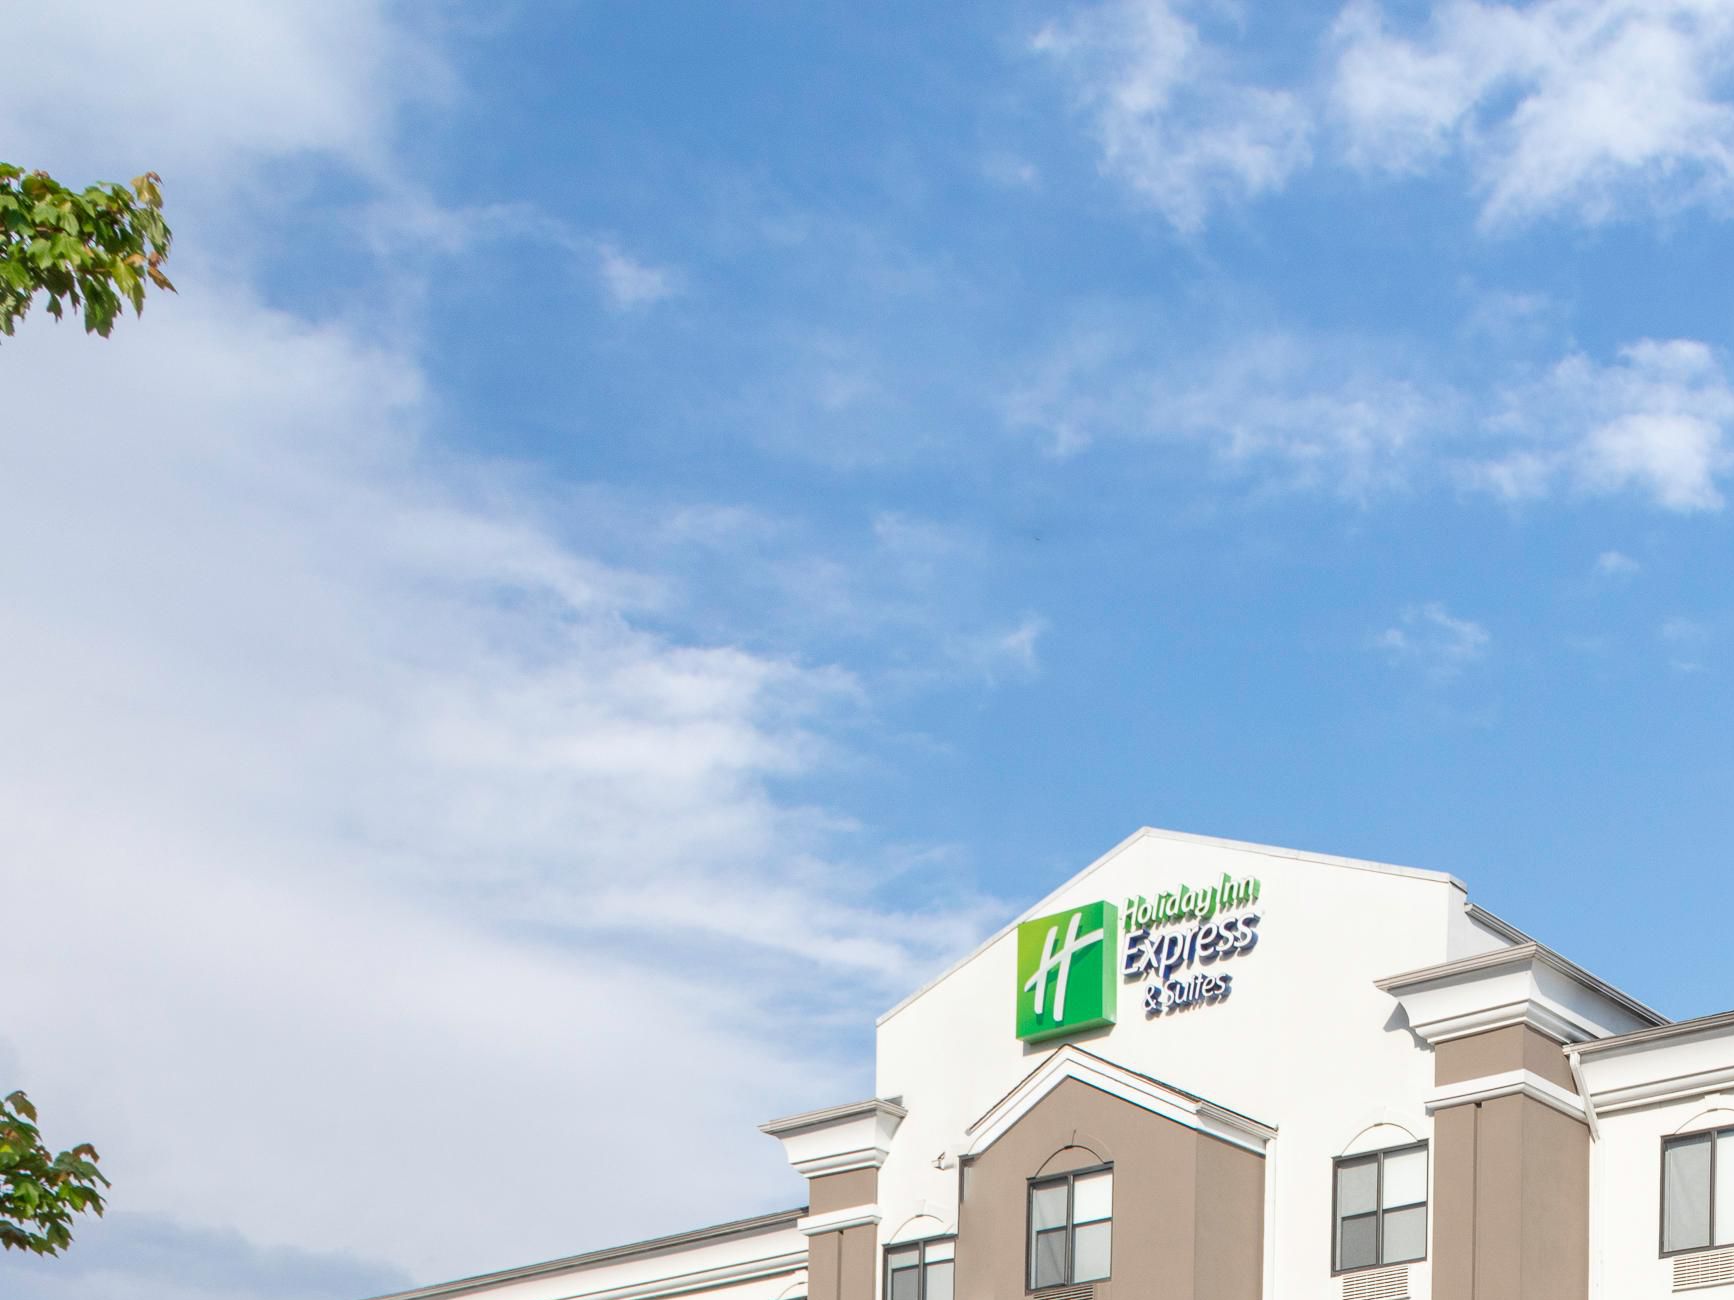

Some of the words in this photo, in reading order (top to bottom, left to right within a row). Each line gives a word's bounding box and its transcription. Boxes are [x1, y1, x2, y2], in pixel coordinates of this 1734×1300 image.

[1123, 883, 1216, 930] Holiday
[1217, 872, 1260, 907] Inn
[1121, 912, 1260, 980] Express
[1143, 983, 1162, 1011] &
[1160, 973, 1232, 1010] Suites
